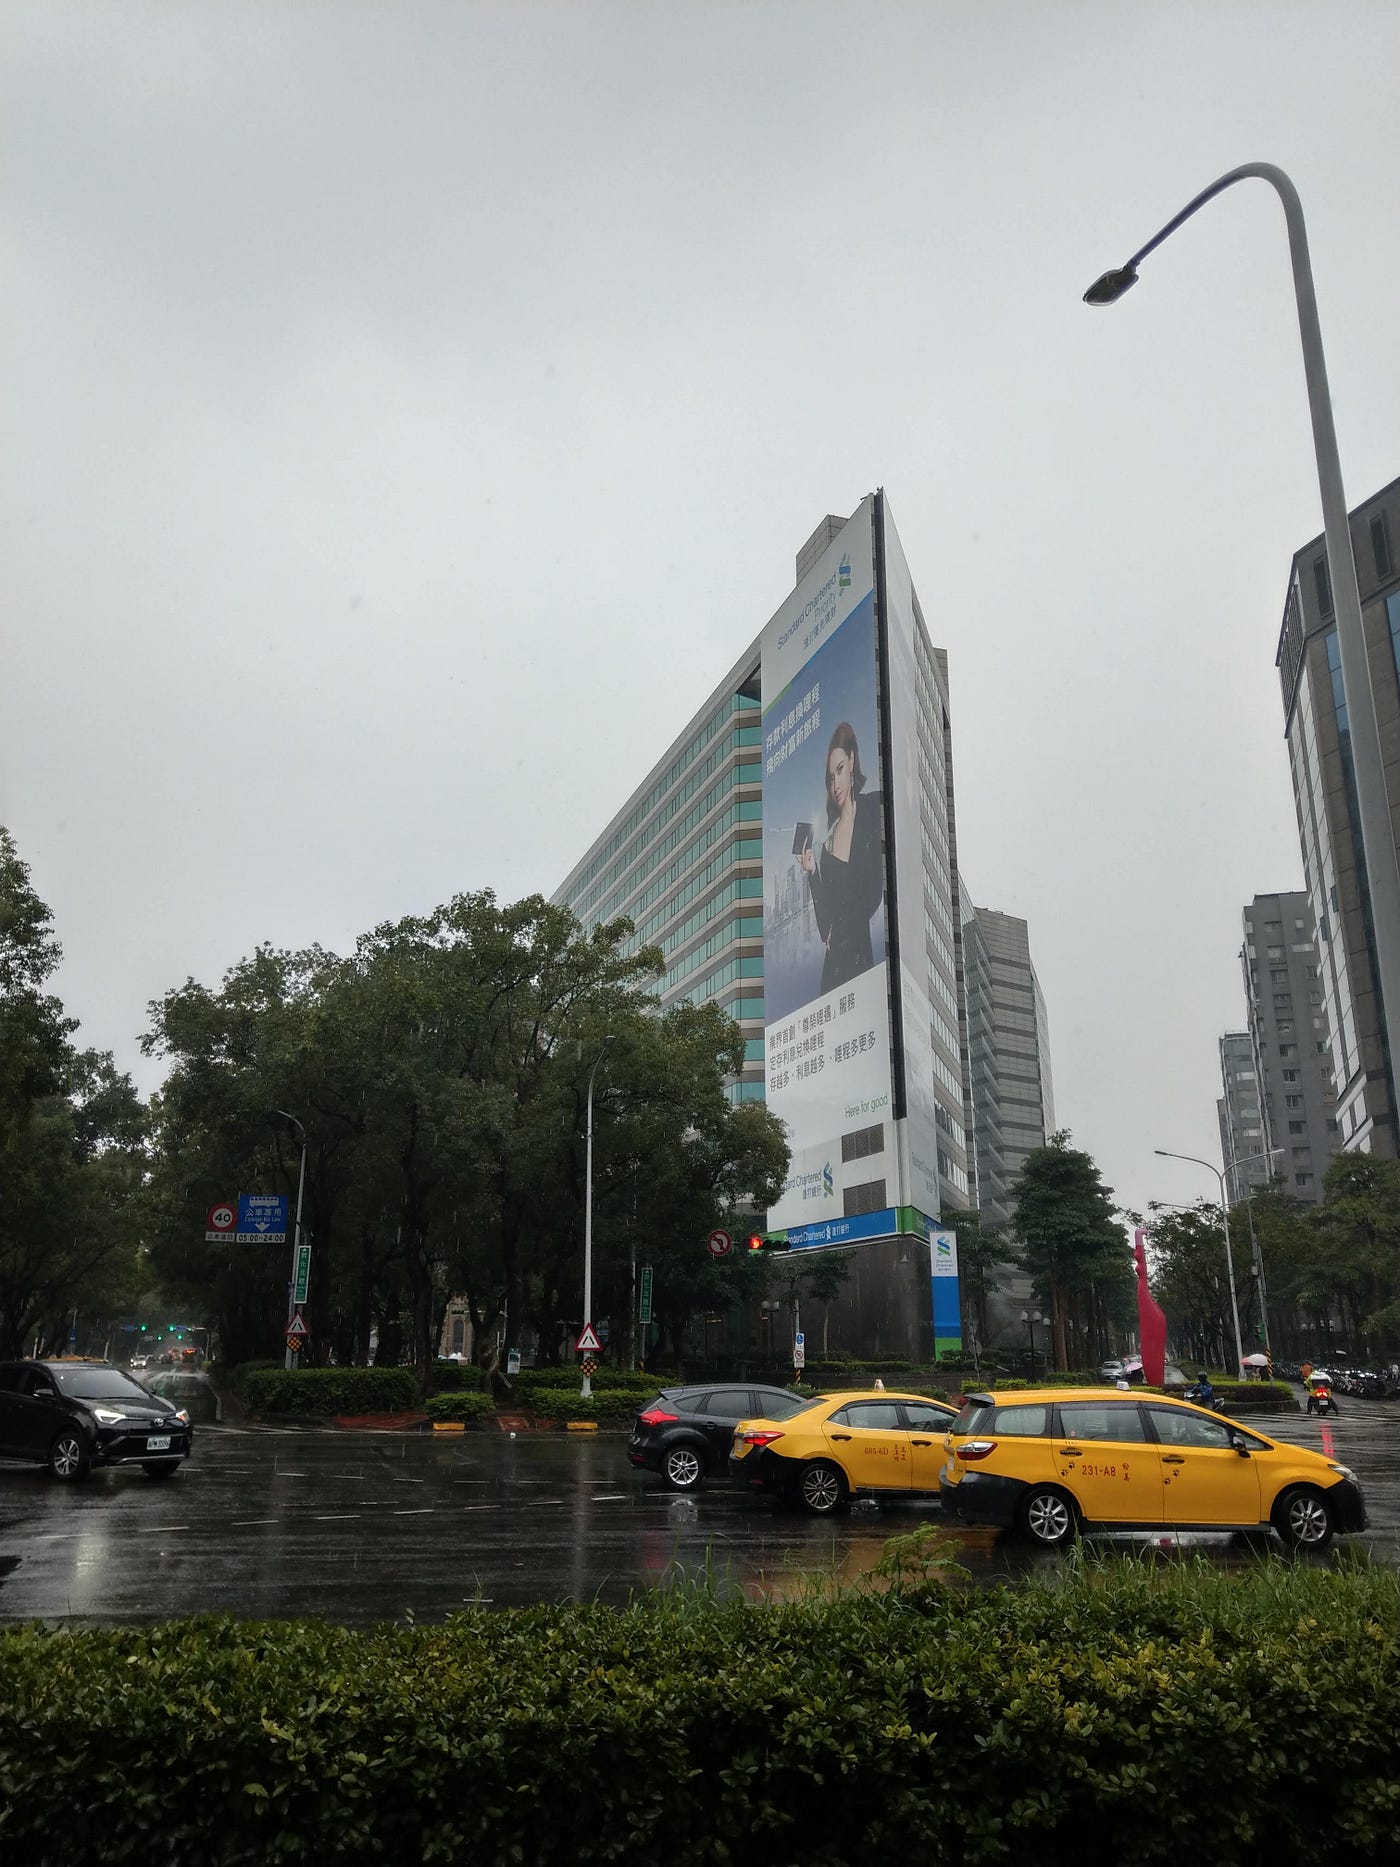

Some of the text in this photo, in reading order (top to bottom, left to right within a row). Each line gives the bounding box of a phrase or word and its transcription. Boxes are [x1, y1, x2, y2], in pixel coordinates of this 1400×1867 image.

[778, 571, 836, 650] Standard Chartered
[845, 1092, 888, 1119] Here for good
[796, 1170, 822, 1187] Chartered
[215, 1213, 231, 1223] 40
[803, 1229, 826, 1242] Chartered
[1082, 1464, 1117, 1477] 231-A8
